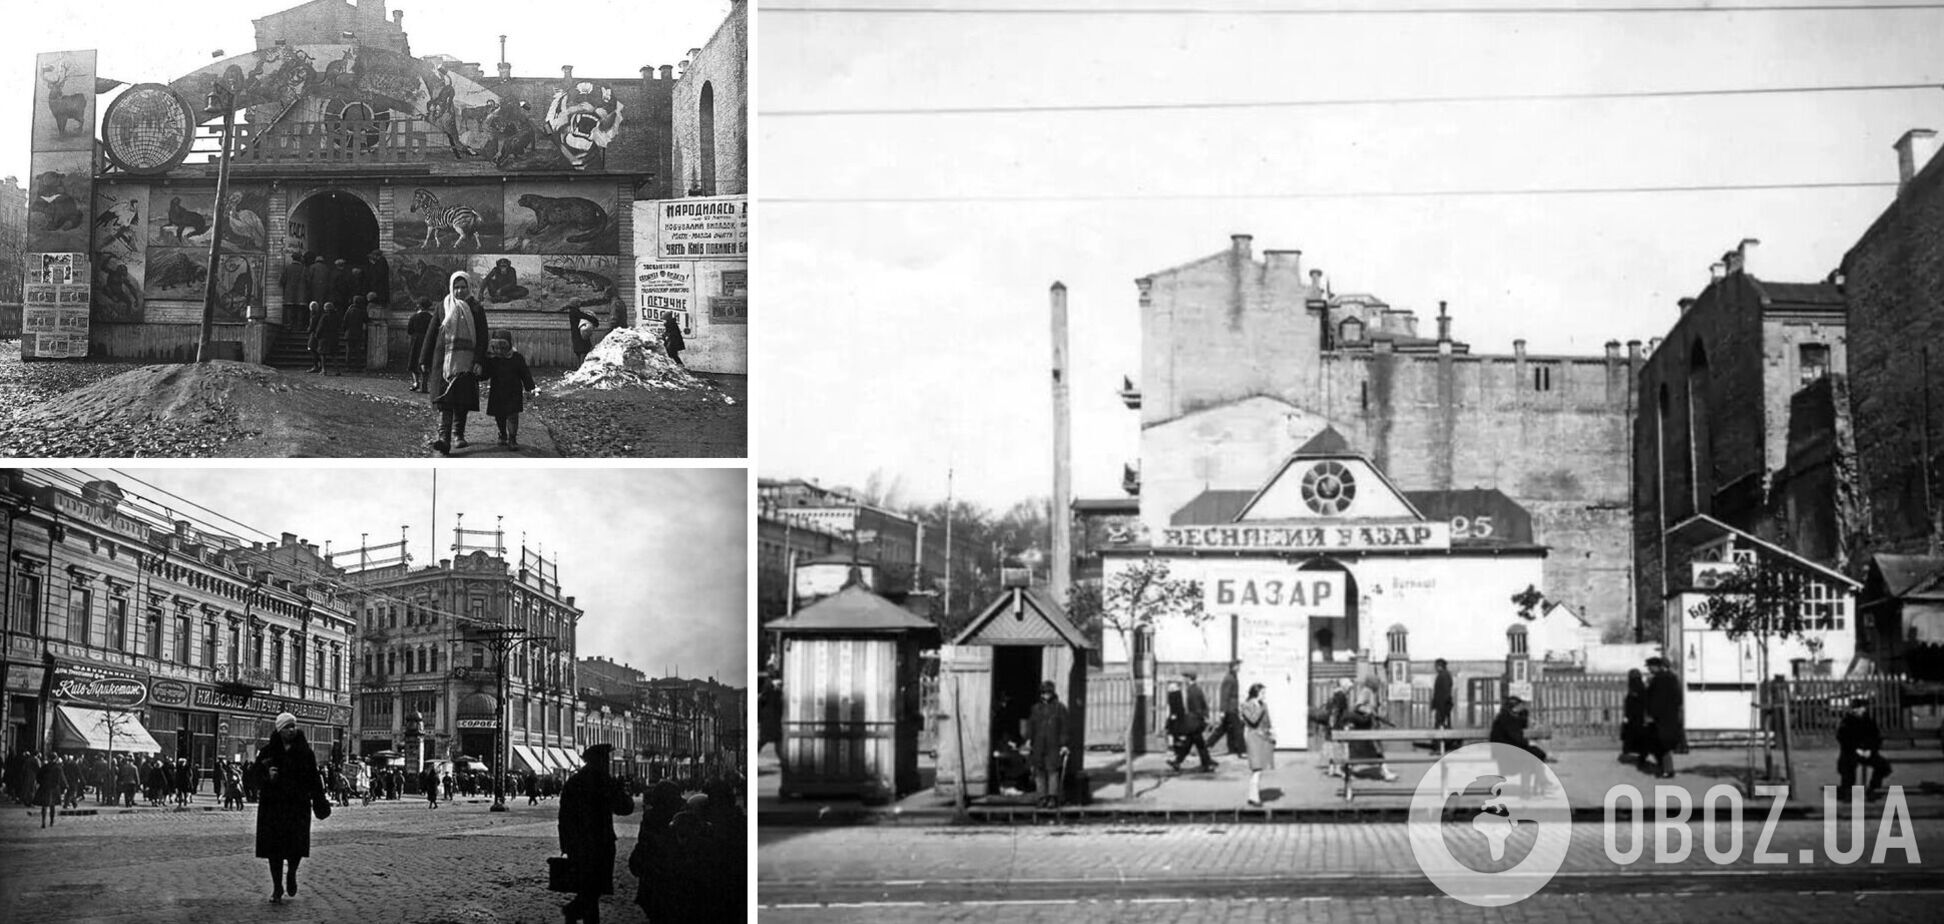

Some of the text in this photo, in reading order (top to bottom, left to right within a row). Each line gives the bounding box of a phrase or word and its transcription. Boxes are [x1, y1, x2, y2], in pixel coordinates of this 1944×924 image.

[666, 203, 735, 218] НАРОДИЛАСЬ
[1451, 515, 1494, 538] 25
[1217, 579, 1332, 607] БАЗАР
[243, 697, 282, 714] АПТЕЧНЕ
